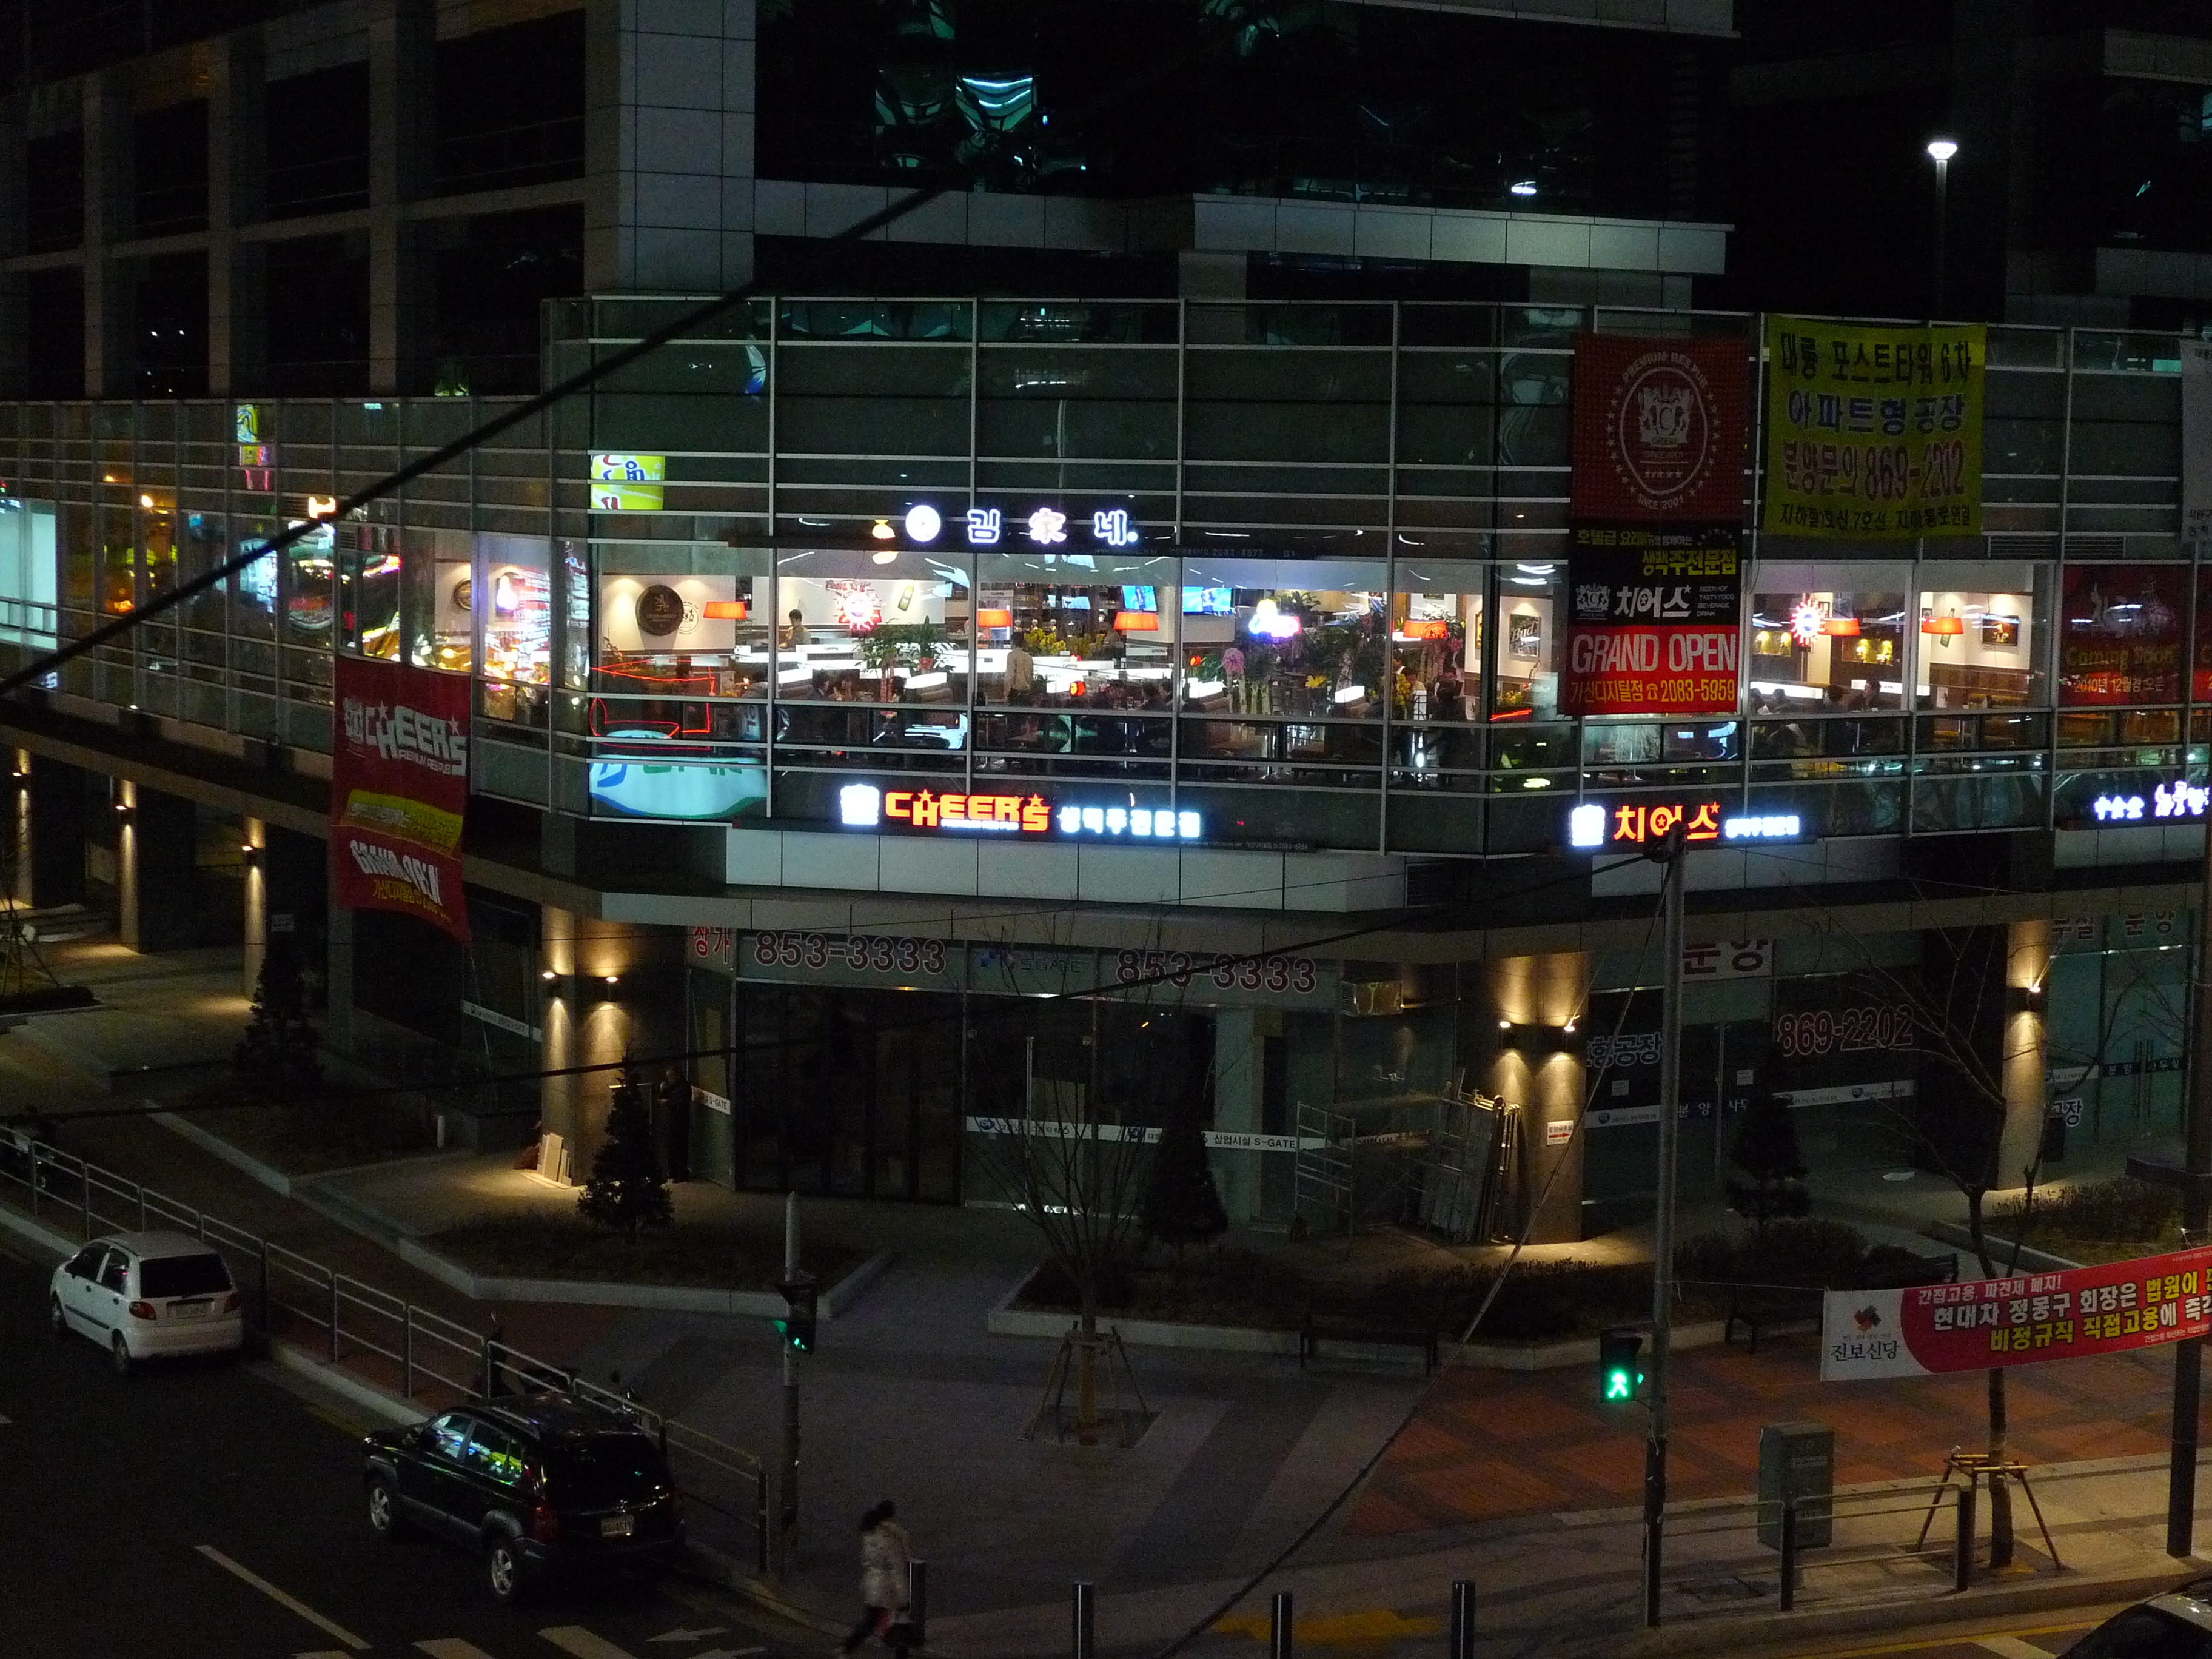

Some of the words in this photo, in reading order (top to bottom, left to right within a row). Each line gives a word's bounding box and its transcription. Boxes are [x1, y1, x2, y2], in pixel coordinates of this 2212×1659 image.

[1831, 340, 1933, 384] 포스트타워
[1783, 438, 1858, 495] 분양문의
[1865, 440, 1965, 501] 869-2202
[1638, 494, 1659, 510] SINCE
[1577, 529, 1617, 546] 호텔급
[1641, 548, 1737, 576] 생맥주전문점
[1614, 585, 1692, 618] 치어스
[1571, 634, 1660, 674] GRAND
[1668, 633, 1736, 672] OPEN
[1569, 679, 1644, 703] 가산디지털점
[1660, 679, 1736, 702] 2083-5959
[365, 700, 467, 777] CHEERS
[885, 789, 1051, 831] CHEERS
[1614, 801, 1721, 842] 치어스
[754, 929, 947, 974] 853-3333
[1115, 948, 1318, 994] 853-3333
[1586, 1032, 1663, 1070] 형공장
[1776, 1004, 1915, 1059] 869-2202
[1213, 1132, 1248, 1147] 상업시설
[1253, 1137, 1296, 1150] S-GATE
[1934, 1302, 2000, 1331] 현대차
[2009, 1292, 2071, 1324] 정몽구
[2080, 1282, 2137, 1314] 회장은
[2145, 1270, 2199, 1303] 법원이
[1984, 1279, 2025, 1298] 파견제
[1989, 1319, 2074, 1352] 비정규직
[2083, 1302, 2177, 1340] 직접고용에
[1830, 1341, 1900, 1362] 진보신당
